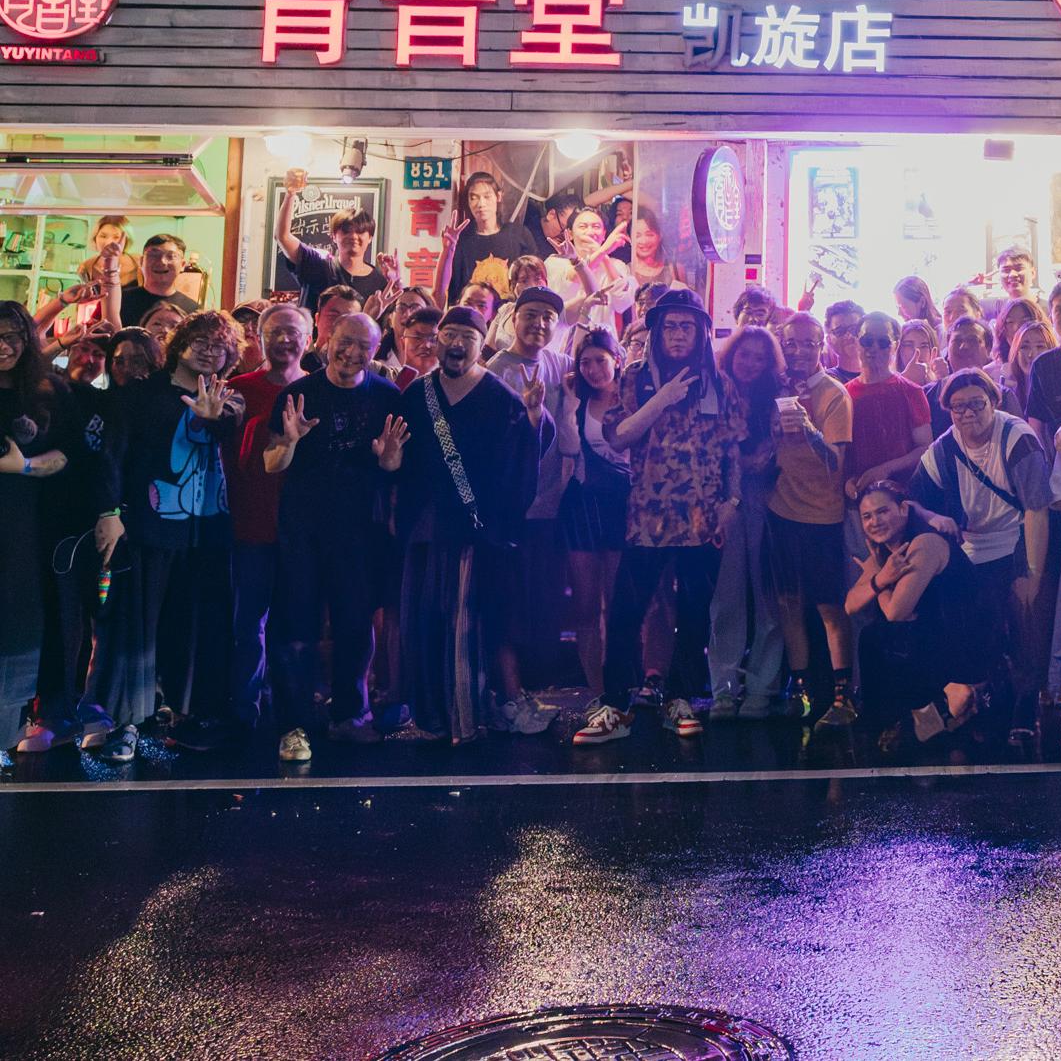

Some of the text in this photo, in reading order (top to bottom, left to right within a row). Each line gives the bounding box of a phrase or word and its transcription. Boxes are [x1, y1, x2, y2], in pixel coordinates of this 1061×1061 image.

[682, 3, 894, 73] 凯旋店
[1, 46, 98, 61] YUYINTANG
[410, 161, 445, 179] 851
